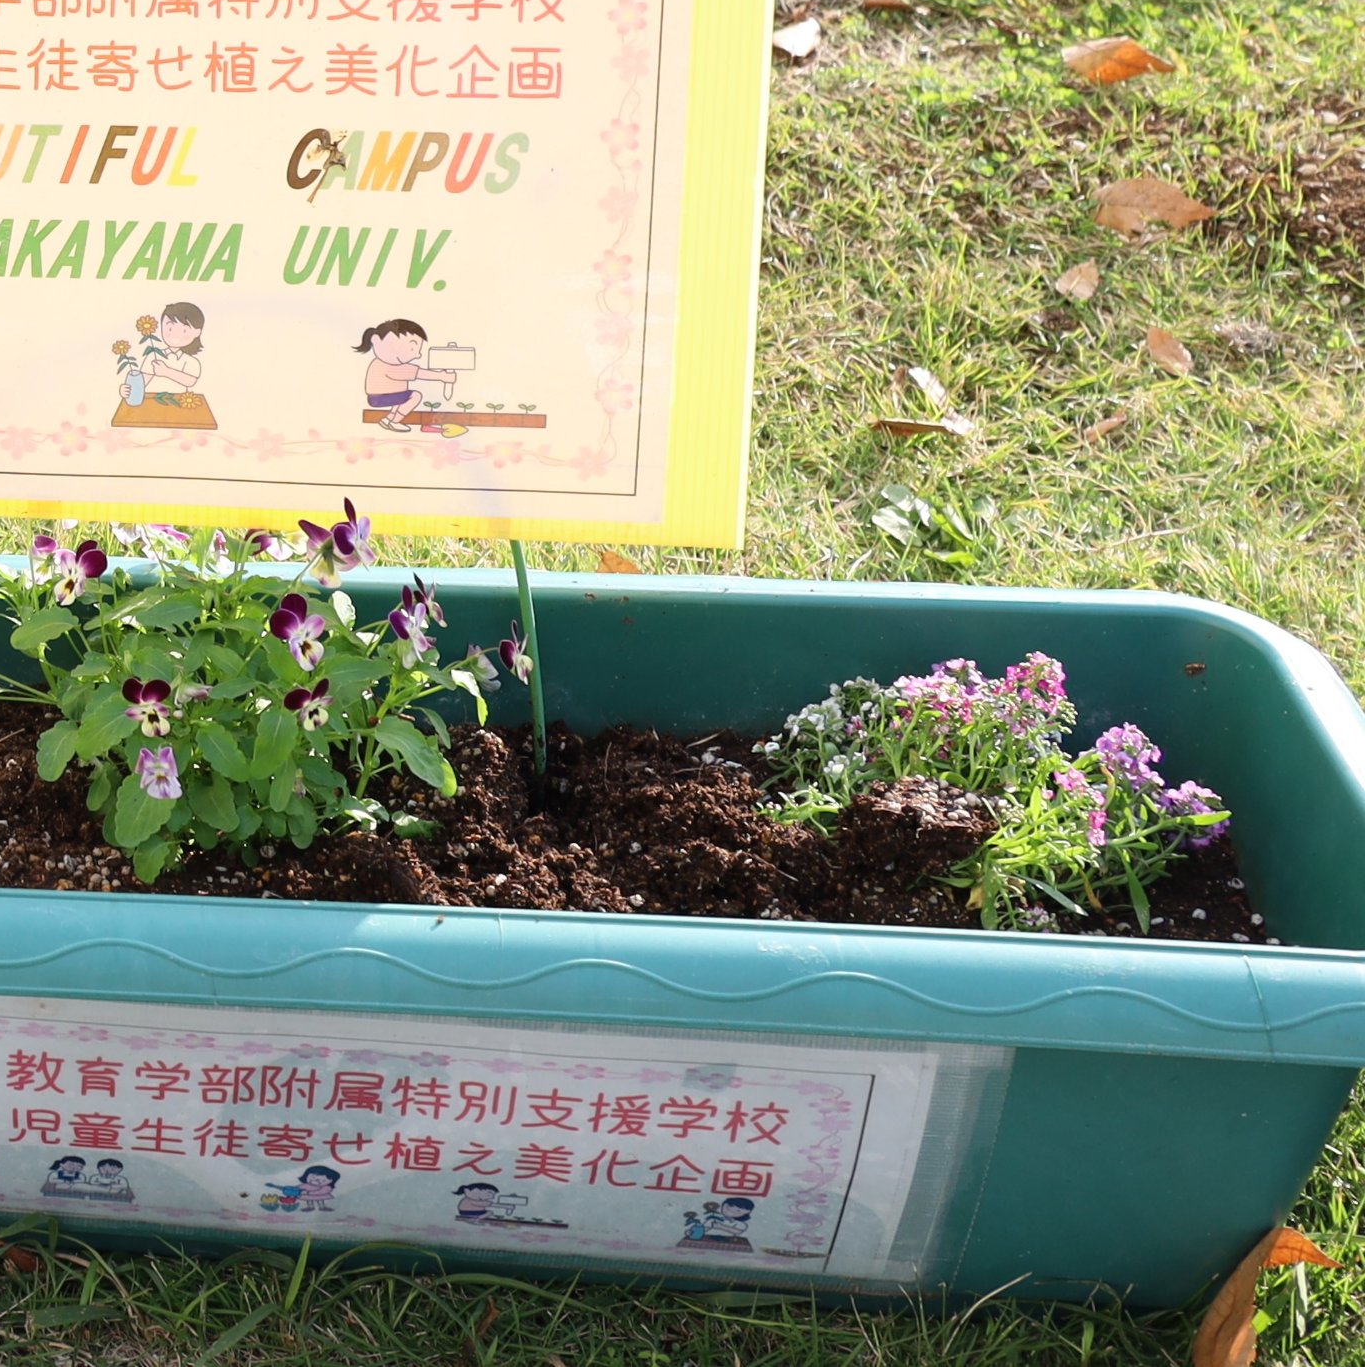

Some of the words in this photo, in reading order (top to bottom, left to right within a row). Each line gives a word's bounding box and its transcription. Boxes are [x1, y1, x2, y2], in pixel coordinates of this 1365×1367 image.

[286, 128, 531, 195] CAMPUS
[283, 225, 453, 292] UNIV.
[4, 1048, 792, 1149] 教育学部附属特別支援学校
[7, 1107, 775, 1200] 児童生徒寄せ植え美化企画
